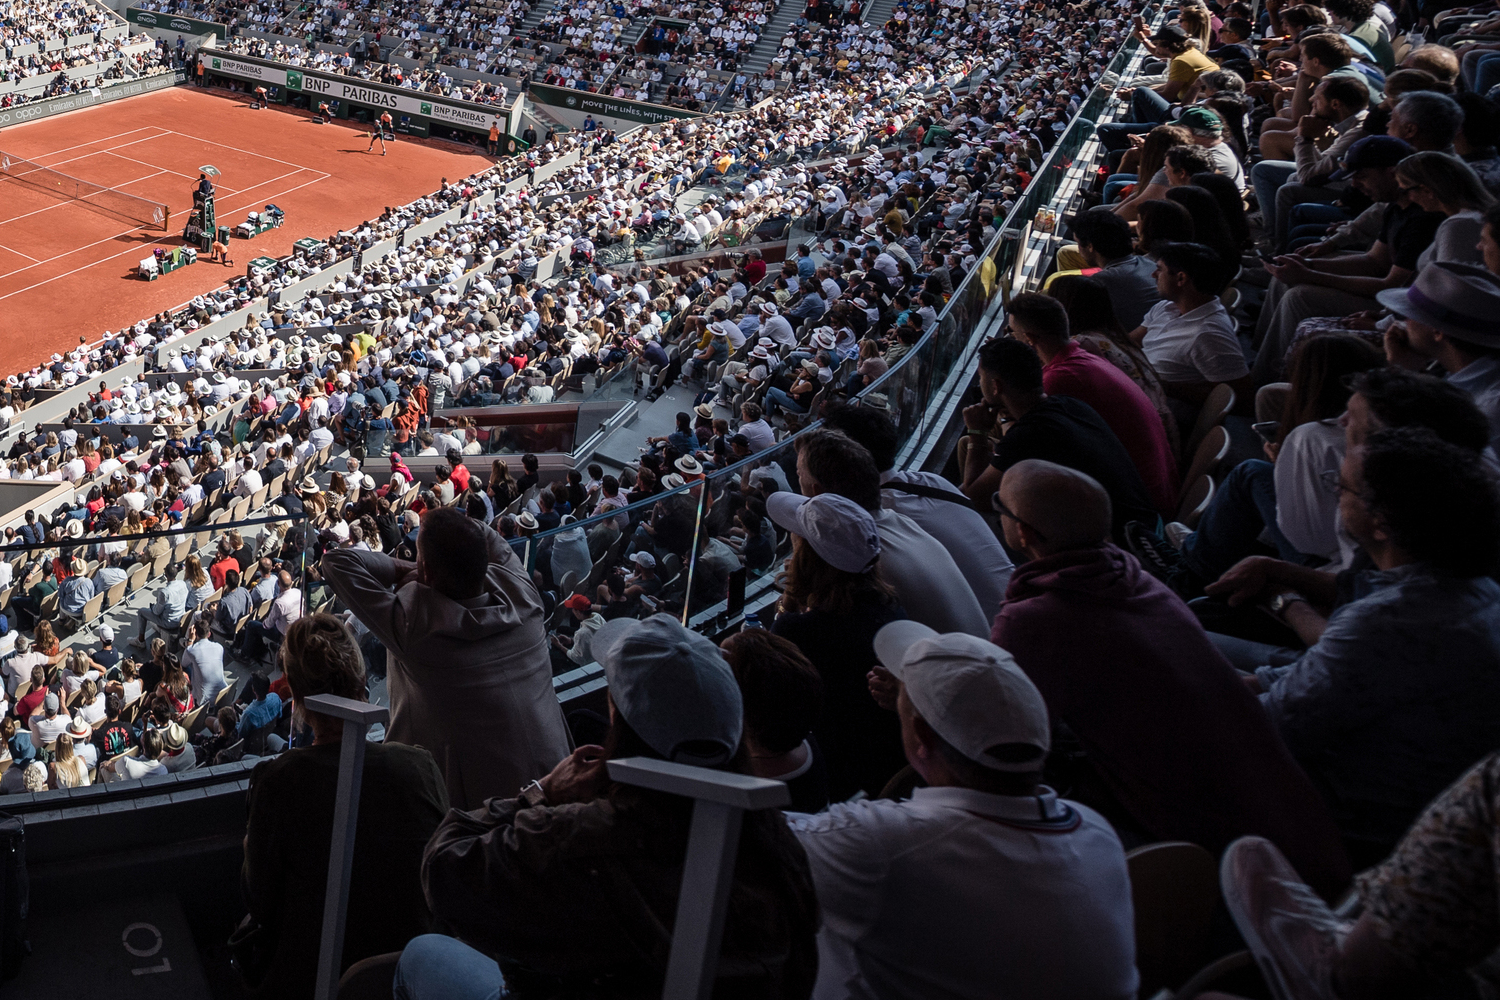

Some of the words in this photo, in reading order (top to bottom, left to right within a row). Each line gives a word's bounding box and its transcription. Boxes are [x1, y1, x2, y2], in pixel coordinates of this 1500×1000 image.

[236, 64, 262, 74] PARIBAS
[146, 78, 167, 90] Emirates
[100, 89, 123, 100] Emirates
[305, 78, 330, 92] BNP
[343, 86, 397, 107] PARIBAS
[48, 100, 75, 112] Emirates
[581, 100, 602, 109] MOVE
[605, 103, 618, 113] THE
[620, 106, 642, 116] LINES,
[643, 111, 662, 122] WITH
[16, 106, 42, 120] oppo
[434, 106, 450, 114] BNP
[452, 110, 486, 122] PARIBAS
